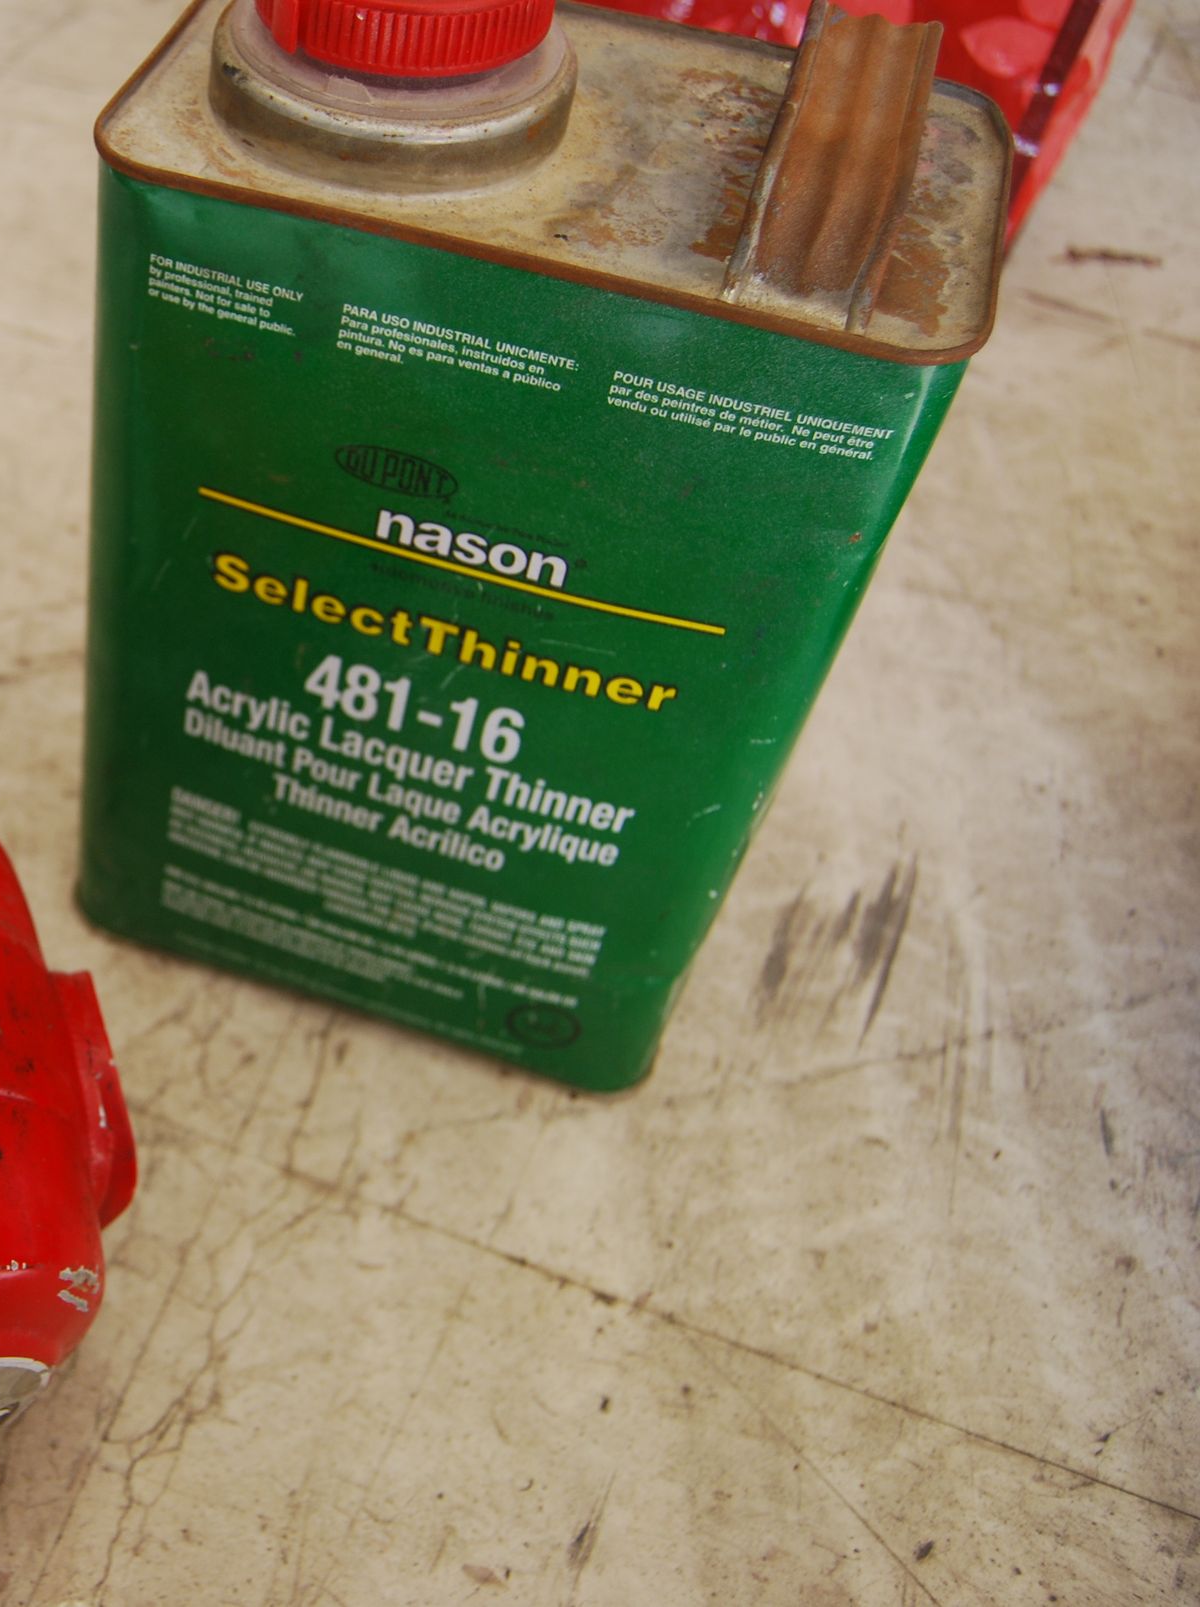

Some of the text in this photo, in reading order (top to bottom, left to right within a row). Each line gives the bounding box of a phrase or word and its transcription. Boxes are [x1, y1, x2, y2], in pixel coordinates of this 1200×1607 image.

[148, 287, 160, 297] or
[161, 291, 181, 304] use
[182, 296, 196, 310] by
[198, 302, 215, 314] the
[216, 308, 257, 327] general
[149, 264, 162, 278] by
[235, 288, 274, 307] trained
[150, 253, 304, 302] FOR INDUSTRIAL USE ONLY
[195, 290, 214, 303] Not
[216, 294, 232, 308] for
[234, 299, 256, 314] sale
[259, 307, 271, 318] to
[336, 340, 404, 366] en general.
[338, 328, 562, 392] pintura. No es para ventas a público
[340, 315, 545, 376] Para profesionales, instruidos en
[342, 303, 580, 372] PARA USO INDUSTRIAL UNICMENTE:
[607, 396, 874, 461] vendu ou utilisé par le public en général.
[609, 385, 632, 397] par
[635, 390, 659, 404] des
[661, 397, 716, 417] peintres
[719, 410, 736, 422] de
[738, 414, 784, 433] métier.
[791, 425, 810, 438] Ne
[813, 431, 845, 445] peut
[613, 370, 895, 440] POUR USAGE INDUSTRIEL UNIQUEMENT
[346, 447, 450, 497] DU PONT
[375, 509, 568, 588] nason
[212, 552, 679, 713] SelectThinner
[304, 654, 525, 764] 481-16
[186, 669, 636, 834] Acrylic Lacquer Thinner
[184, 706, 620, 867] Diluant Pour Laque Acrylique
[273, 772, 384, 833] Thinner
